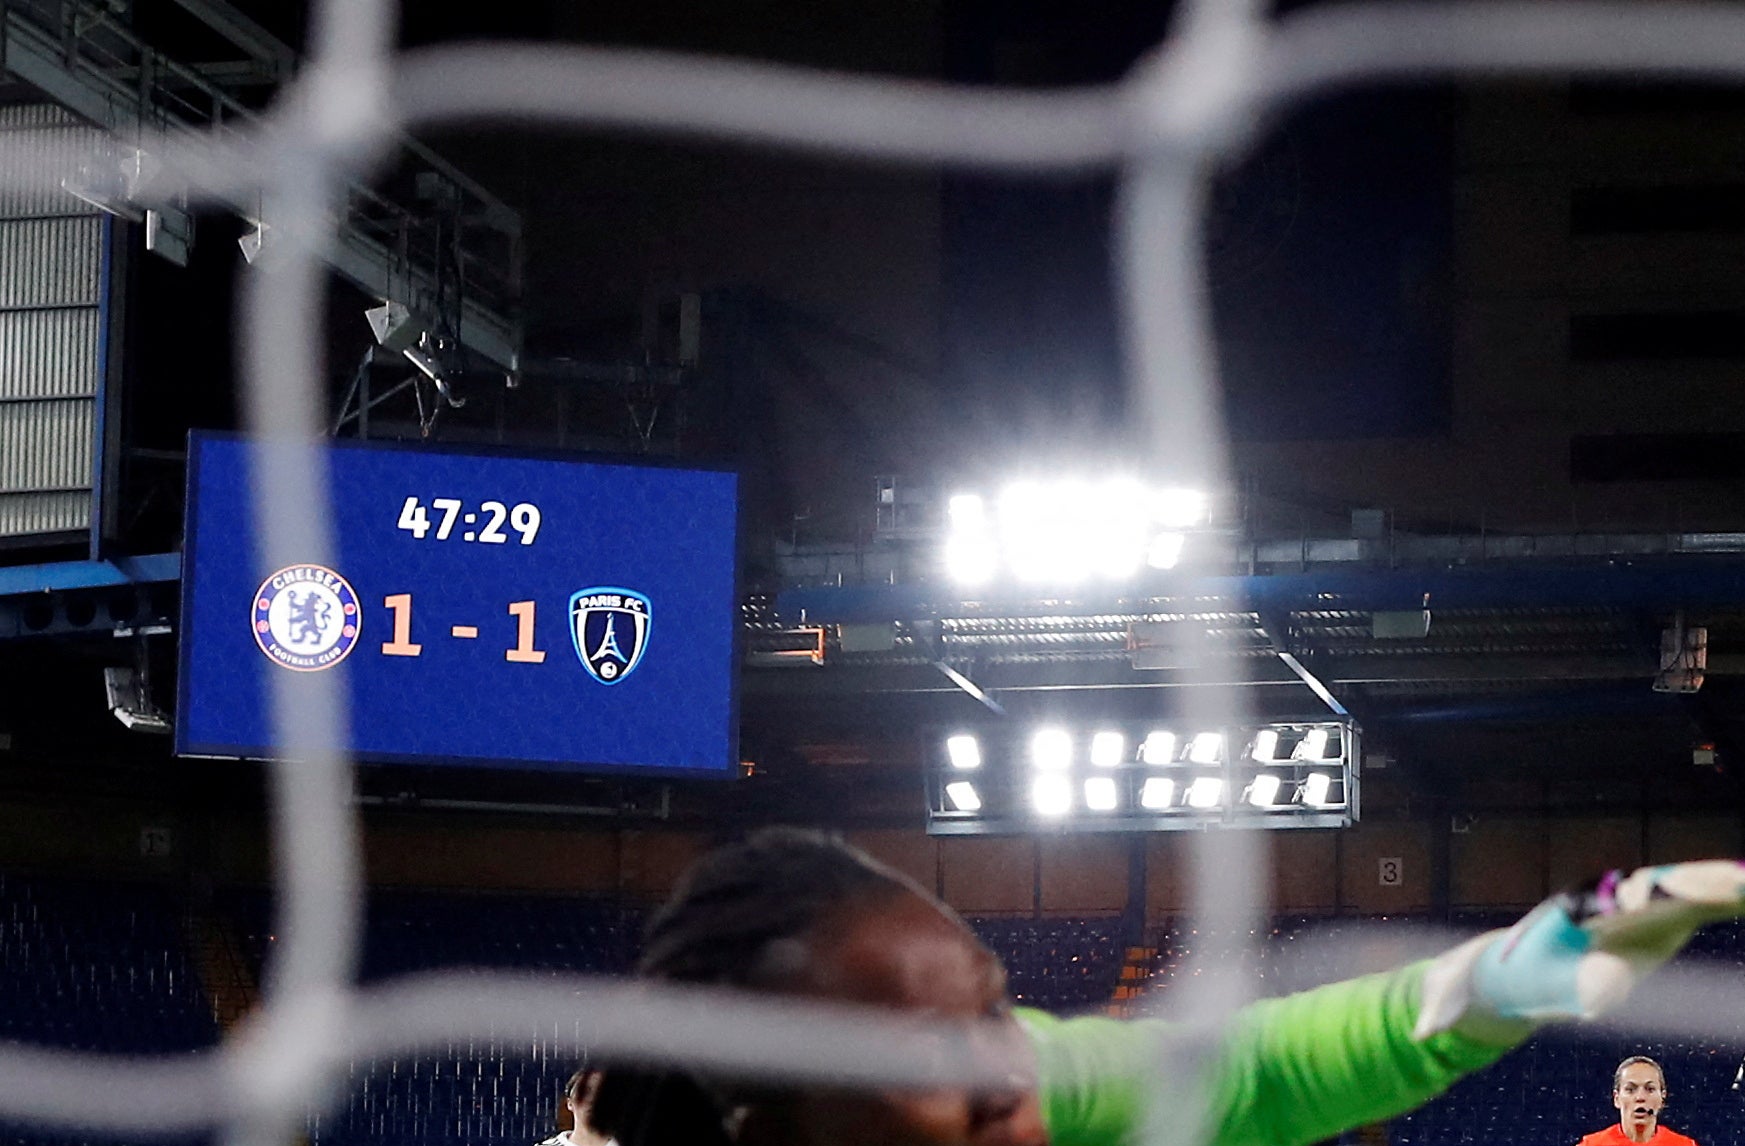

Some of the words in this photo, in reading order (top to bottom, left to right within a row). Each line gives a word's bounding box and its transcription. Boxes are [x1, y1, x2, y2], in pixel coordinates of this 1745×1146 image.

[397, 496, 541, 545] 47:29
[272, 568, 342, 594] CHELSEA
[579, 594, 621, 609] PARIS
[624, 597, 643, 611] FC
[382, 593, 422, 656] 1
[506, 600, 546, 663] 1
[1383, 861, 1397, 883] 3
